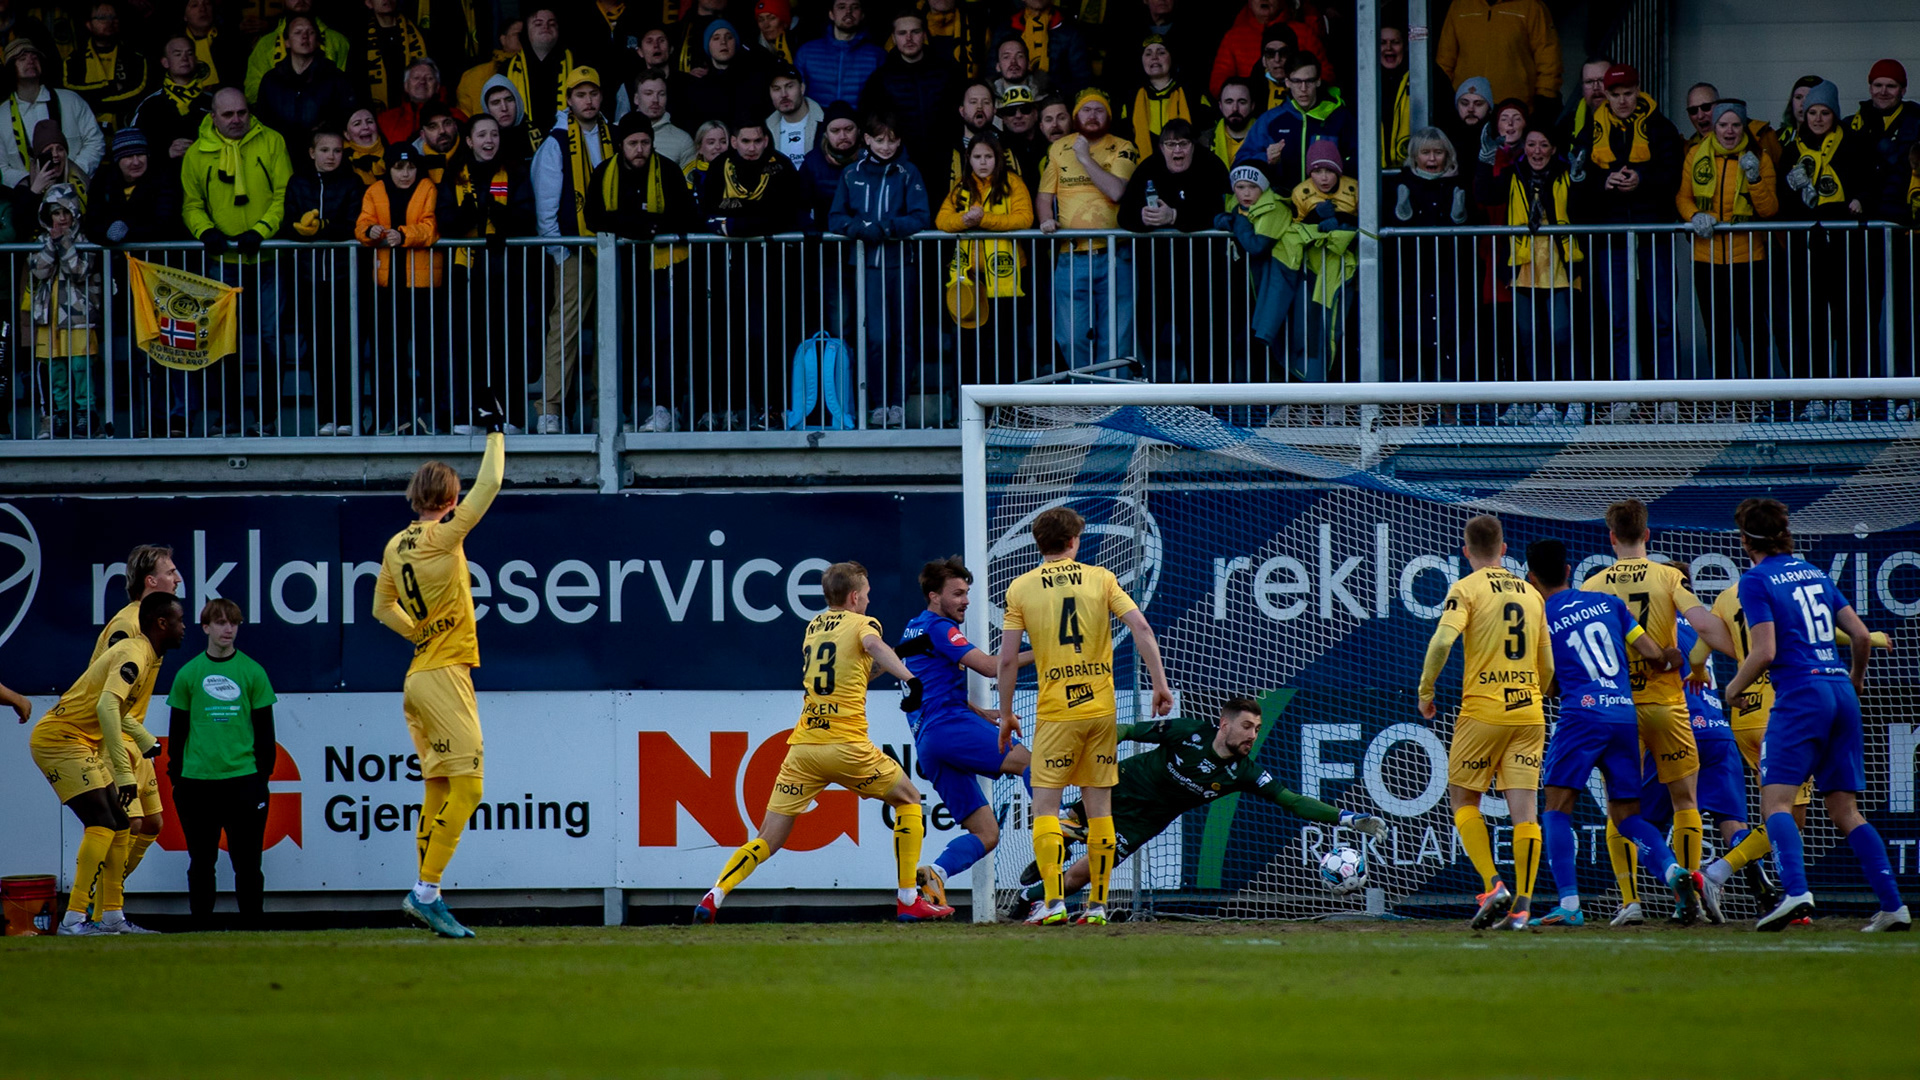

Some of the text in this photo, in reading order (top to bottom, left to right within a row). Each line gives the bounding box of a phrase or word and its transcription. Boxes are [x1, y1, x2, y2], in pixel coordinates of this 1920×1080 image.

[1041, 563, 1082, 575] ACTION
[1608, 563, 1648, 572] ACTION
[1769, 569, 1828, 586] HARMONIE
[402, 562, 428, 621] 9
[1059, 596, 1083, 653] 4
[1503, 602, 1526, 661] 3
[1791, 583, 1834, 644] 15
[1565, 621, 1620, 682] 10
[1479, 671, 1535, 685] SAMPST
[324, 745, 424, 782] Nors
[1514, 753, 1540, 769] nob
[82, 774, 90, 786] 5
[324, 793, 590, 840] Gjennning
